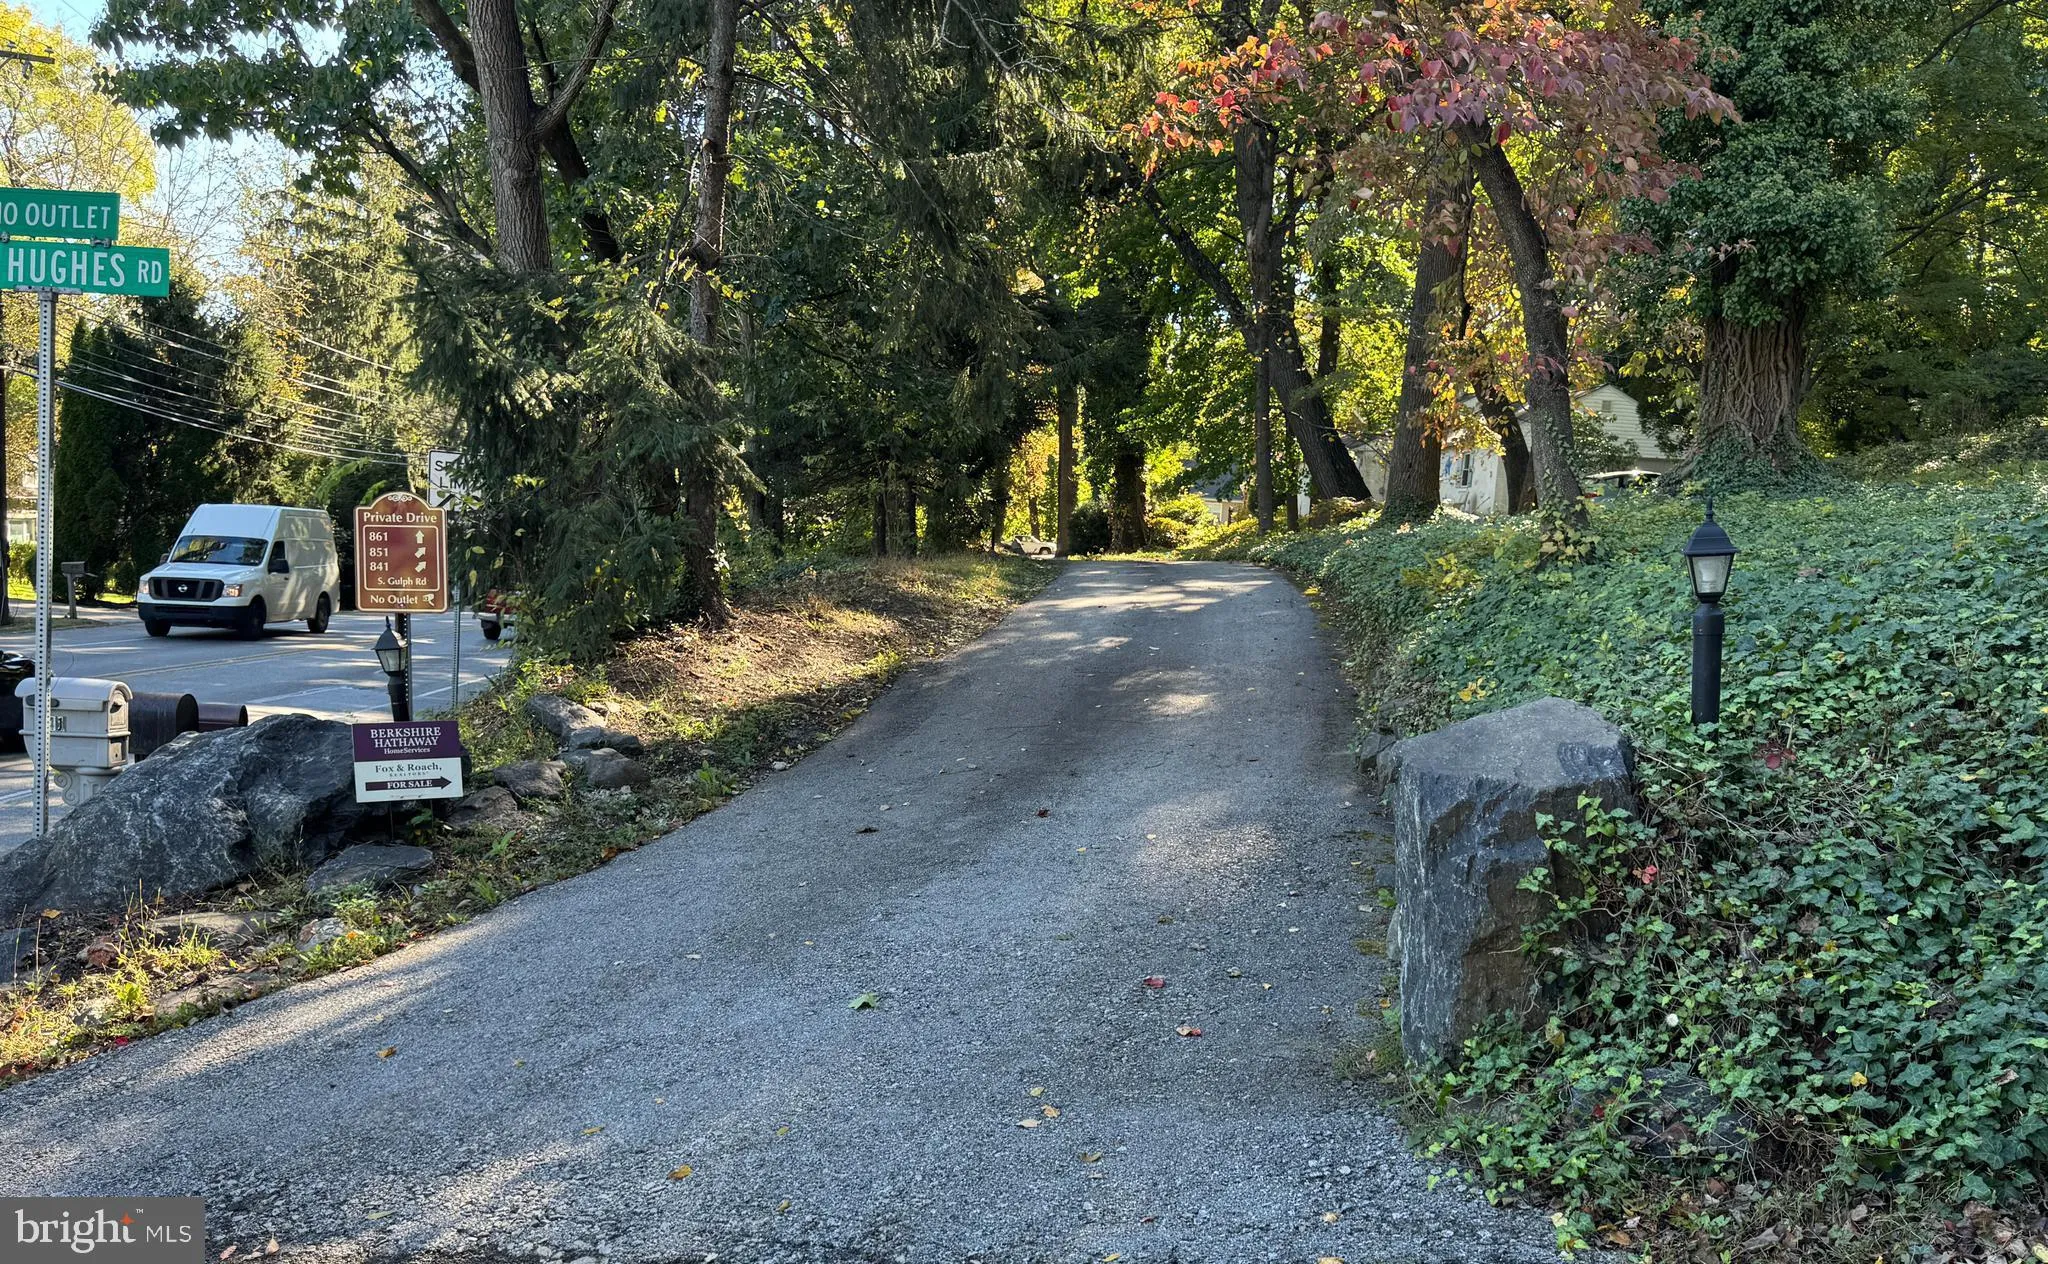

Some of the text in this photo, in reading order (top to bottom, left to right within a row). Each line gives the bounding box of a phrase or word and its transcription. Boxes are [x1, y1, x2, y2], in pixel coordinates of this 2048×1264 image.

[0, 201, 111, 229] O OUTLET
[7, 247, 162, 288] HUGHES RD
[363, 511, 438, 523] Private Drive
[369, 531, 388, 542] 861
[369, 547, 389, 557] 851
[369, 561, 389, 572] 841
[377, 576, 427, 588] S. Gulph Rd
[370, 594, 418, 605] No Outlet
[370, 727, 441, 738] BERKSHIRE
[375, 737, 439, 747] HATHAWAY
[375, 762, 442, 773] Fox & Roach,
[387, 779, 433, 789] FOR SALE
